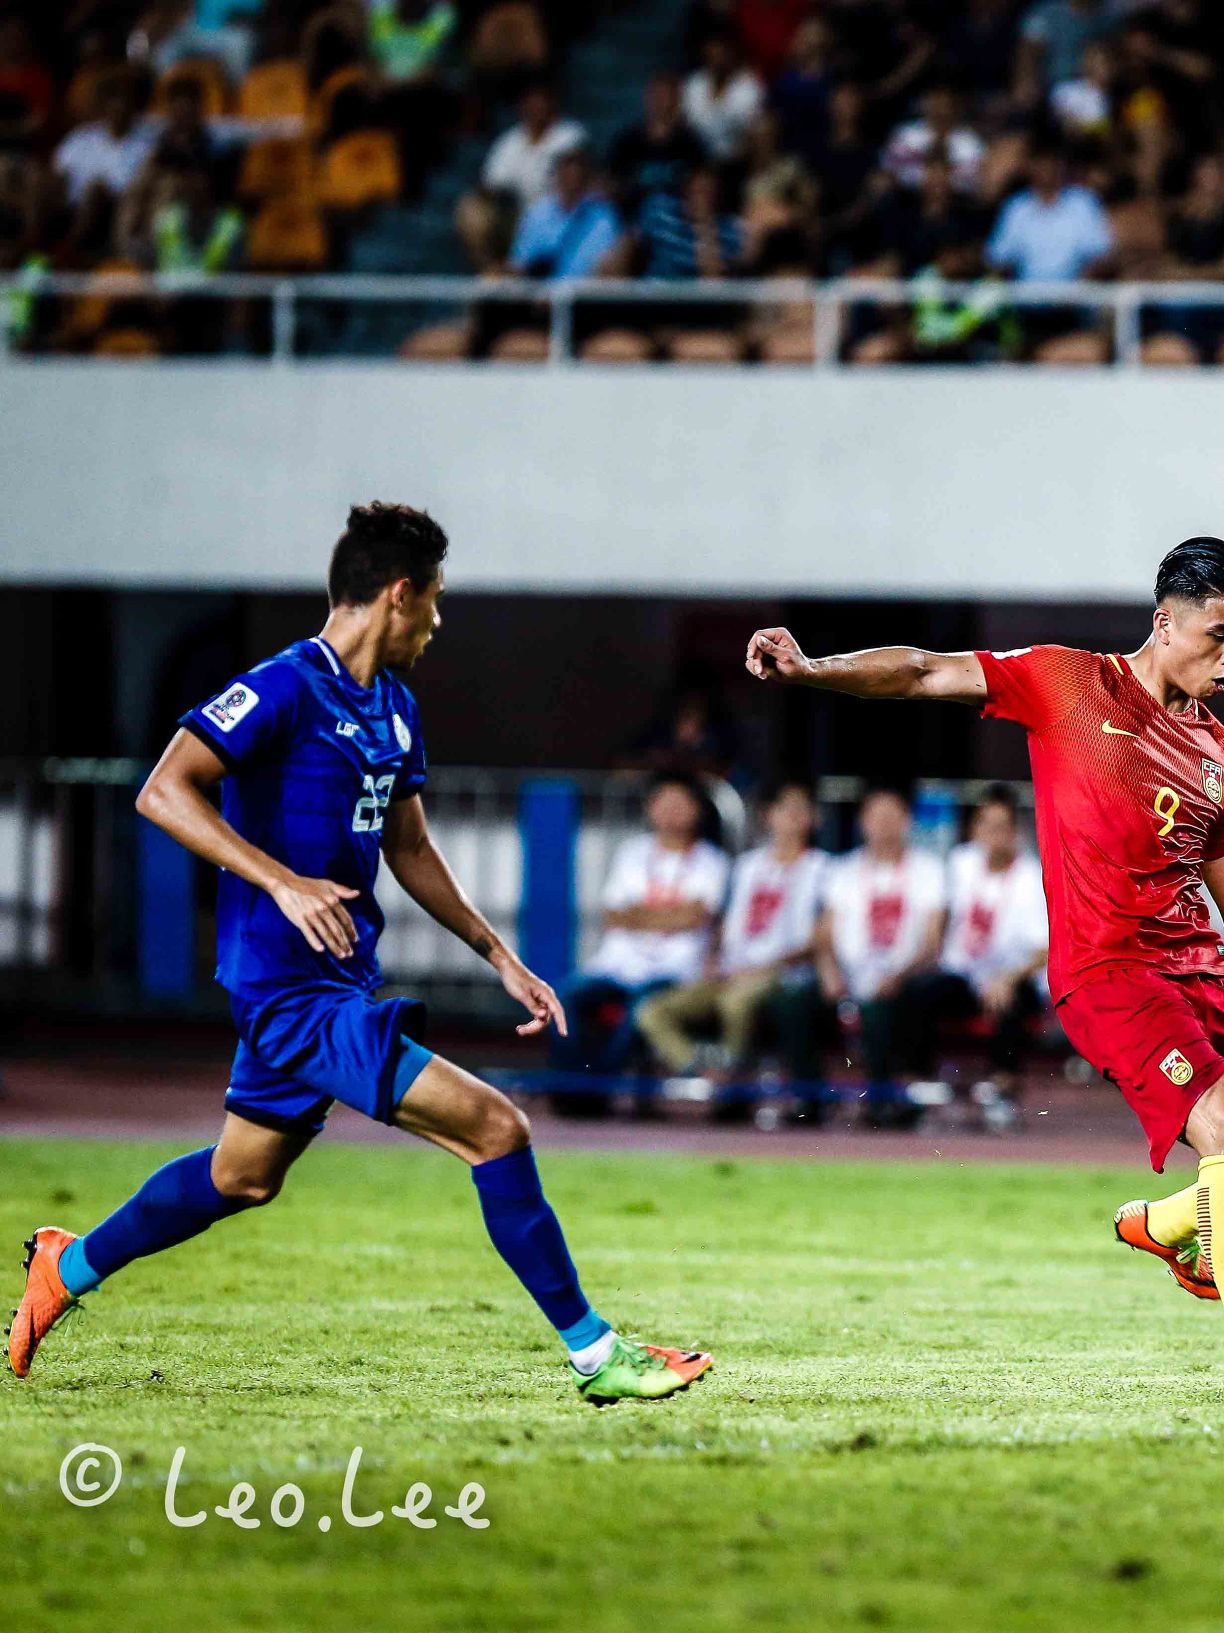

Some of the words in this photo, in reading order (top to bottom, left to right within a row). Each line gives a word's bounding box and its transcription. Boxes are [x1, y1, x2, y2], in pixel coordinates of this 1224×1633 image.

[1203, 761, 1221, 775] CFA
[352, 774, 395, 832] 22
[1154, 787, 1180, 836] 9
